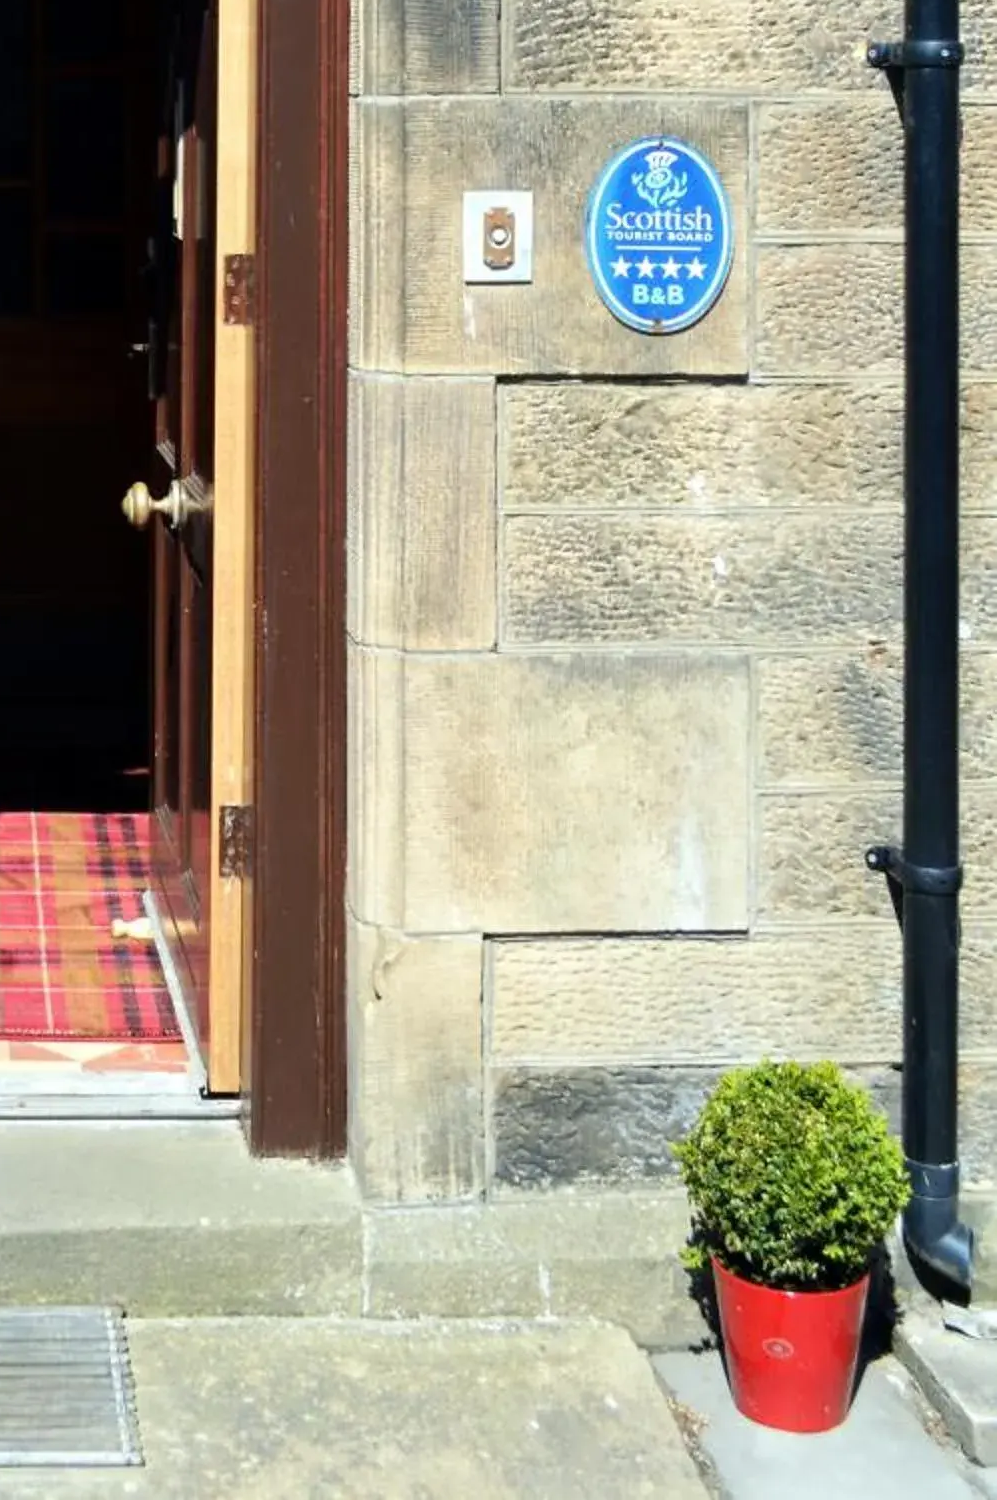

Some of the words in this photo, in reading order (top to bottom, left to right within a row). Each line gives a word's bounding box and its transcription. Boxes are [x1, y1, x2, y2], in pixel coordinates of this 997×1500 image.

[606, 203, 712, 231] Scottish
[607, 231, 662, 242] TOURIST
[668, 232, 713, 242] BOARD
[633, 284, 684, 306] B&B
